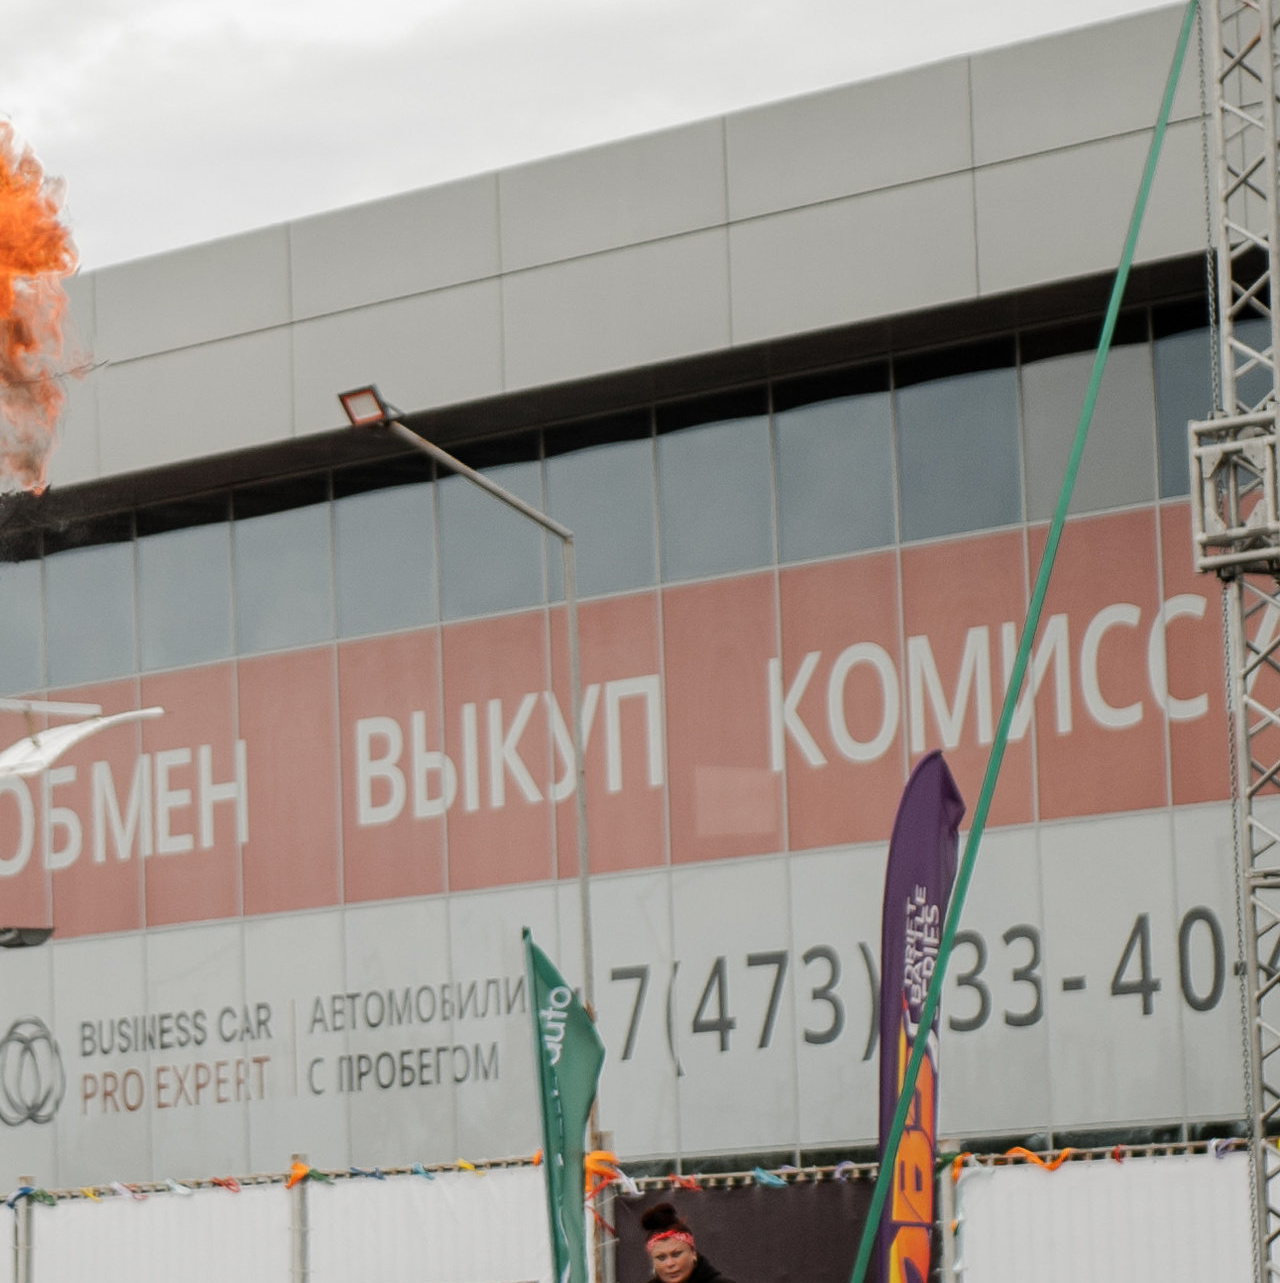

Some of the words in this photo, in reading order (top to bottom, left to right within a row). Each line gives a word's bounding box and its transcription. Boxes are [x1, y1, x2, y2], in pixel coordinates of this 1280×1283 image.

[356, 673, 664, 825] ВЫКУП
[903, 896, 917, 987] DRIFT
[81, 1008, 208, 1057] BUSINESS
[219, 1002, 274, 1043] CAR
[309, 975, 526, 1034] АВТОМОБИЛИ
[81, 1068, 145, 1115] PRO
[156, 1055, 271, 1108] EXPERT
[308, 1057, 326, 1095] С
[337, 1041, 500, 1092] ПРОБЕГОМ
